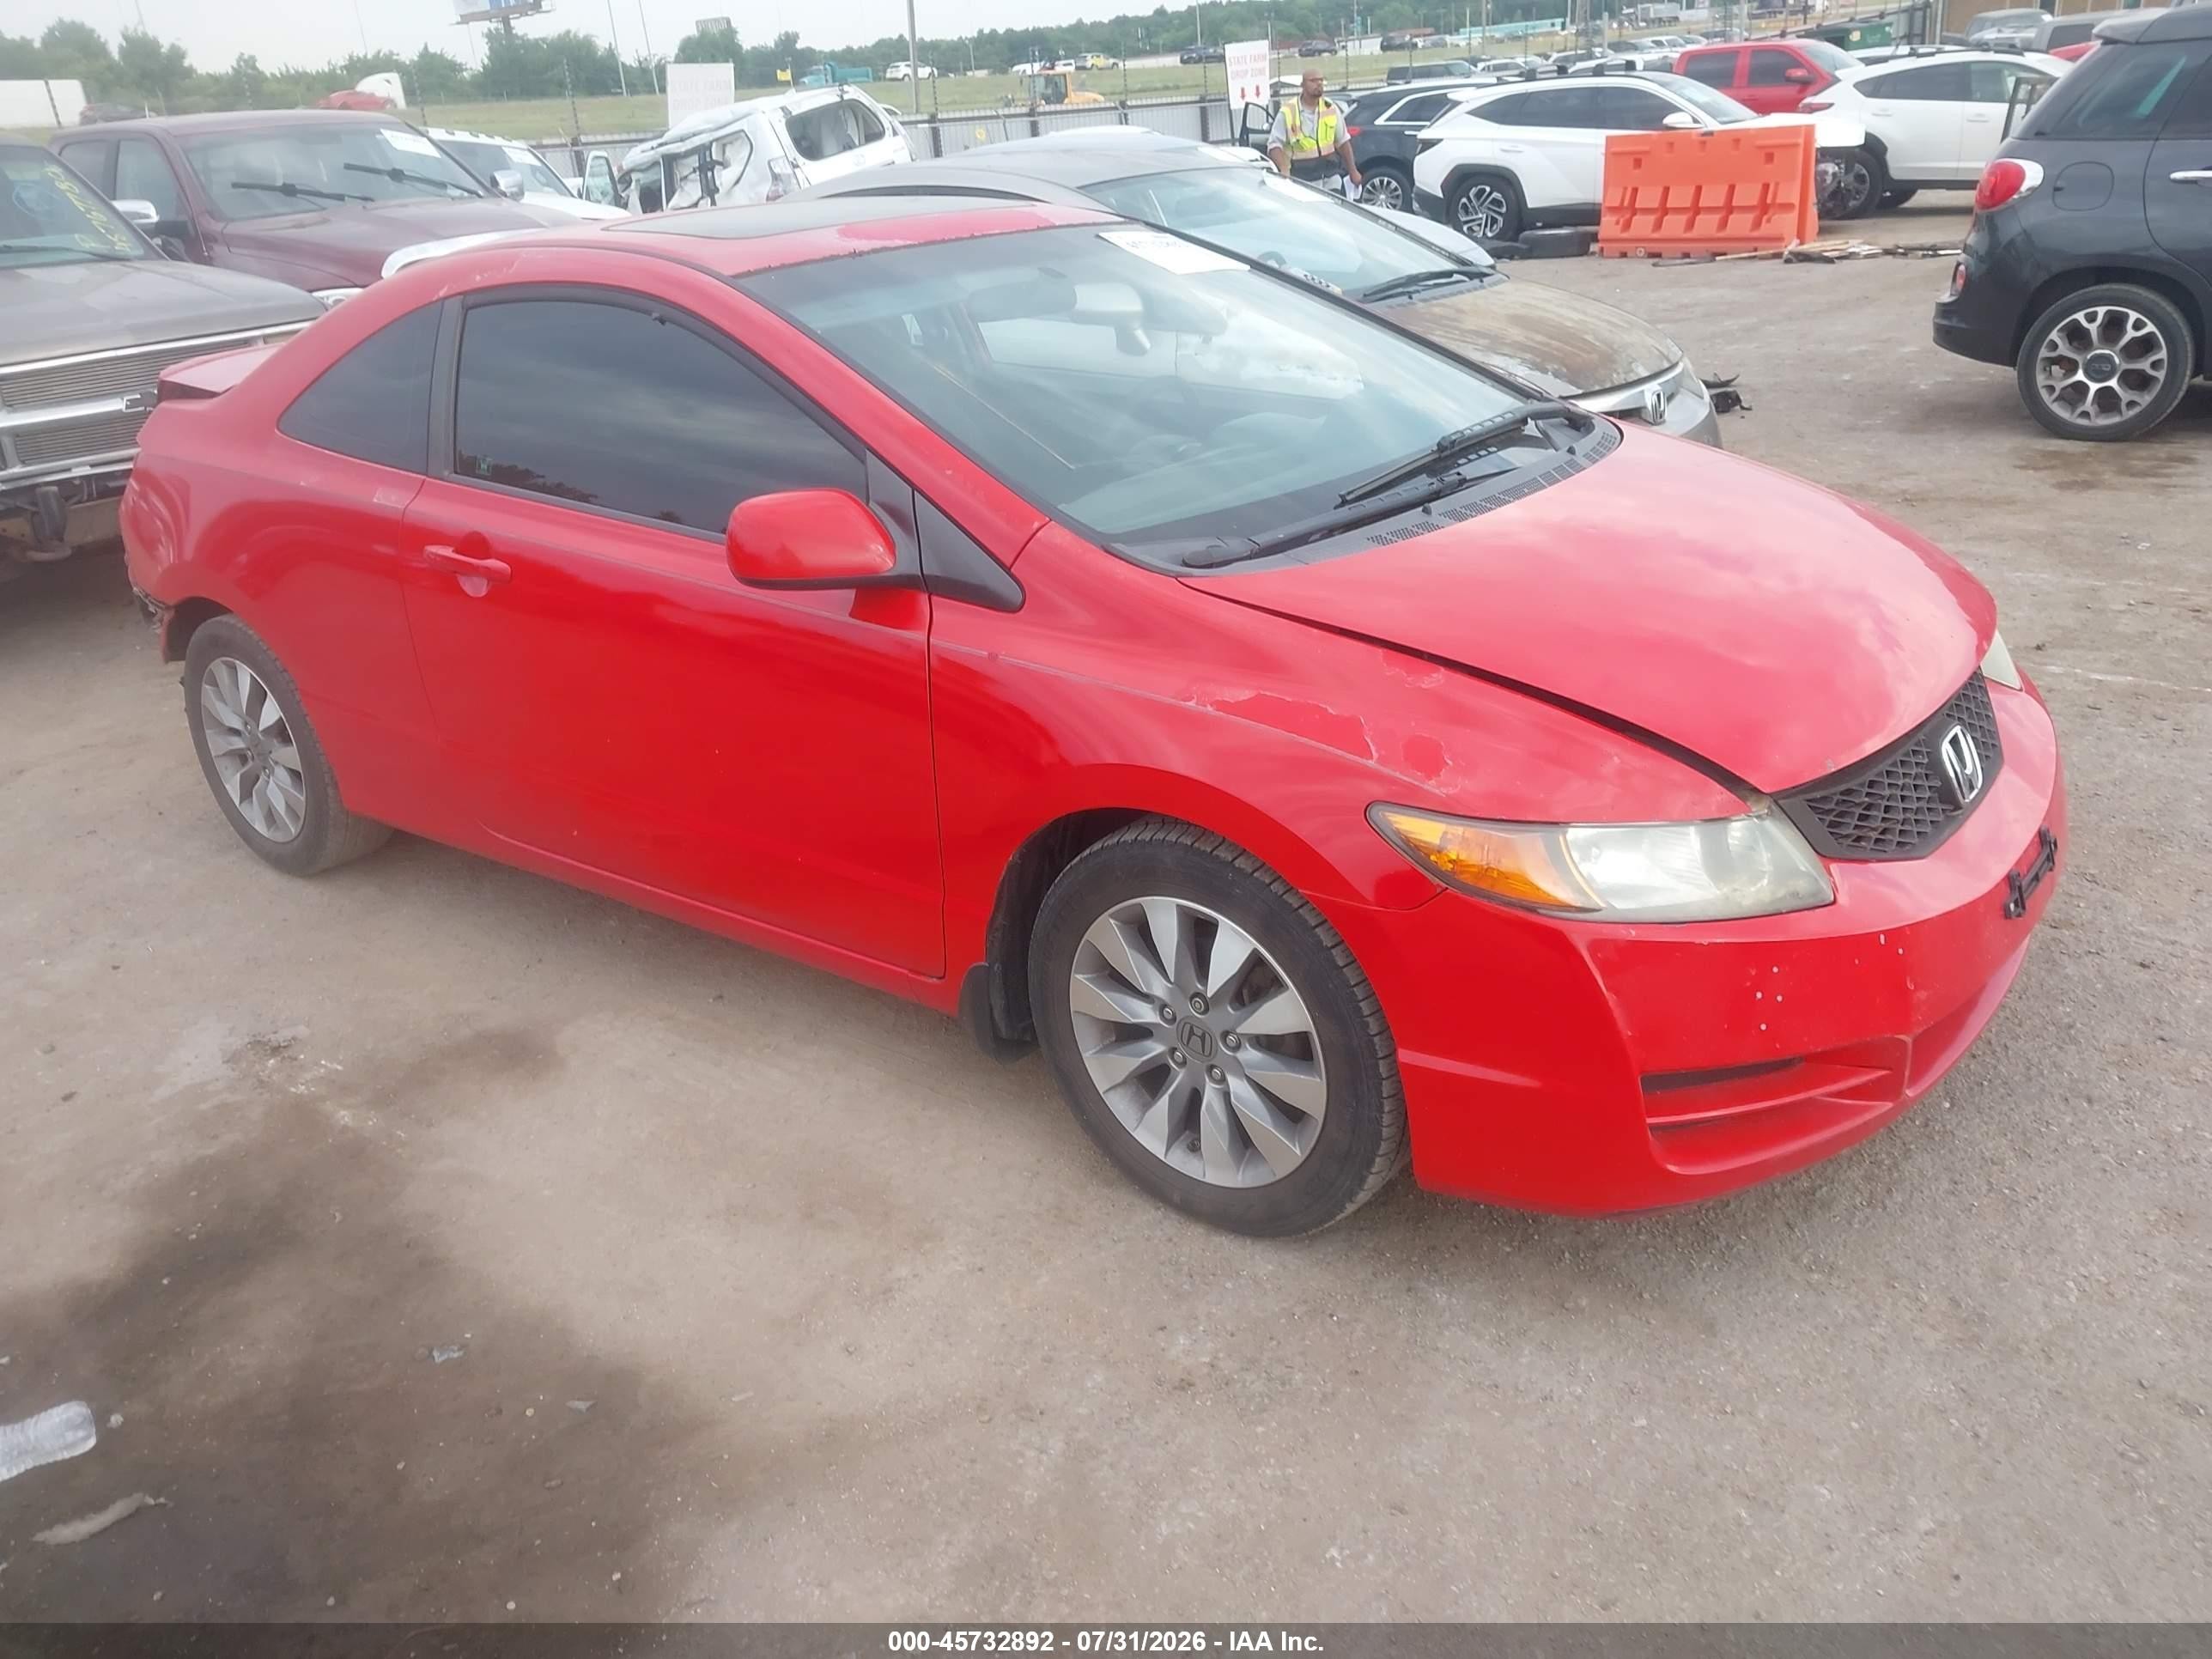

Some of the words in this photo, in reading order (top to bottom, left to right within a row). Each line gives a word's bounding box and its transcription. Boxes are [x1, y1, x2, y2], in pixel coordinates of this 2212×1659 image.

[1229, 55, 1248, 67] STATE
[1249, 53, 1267, 63] FARM
[1231, 69, 1249, 81] DROP
[1250, 67, 1267, 77] ZONE
